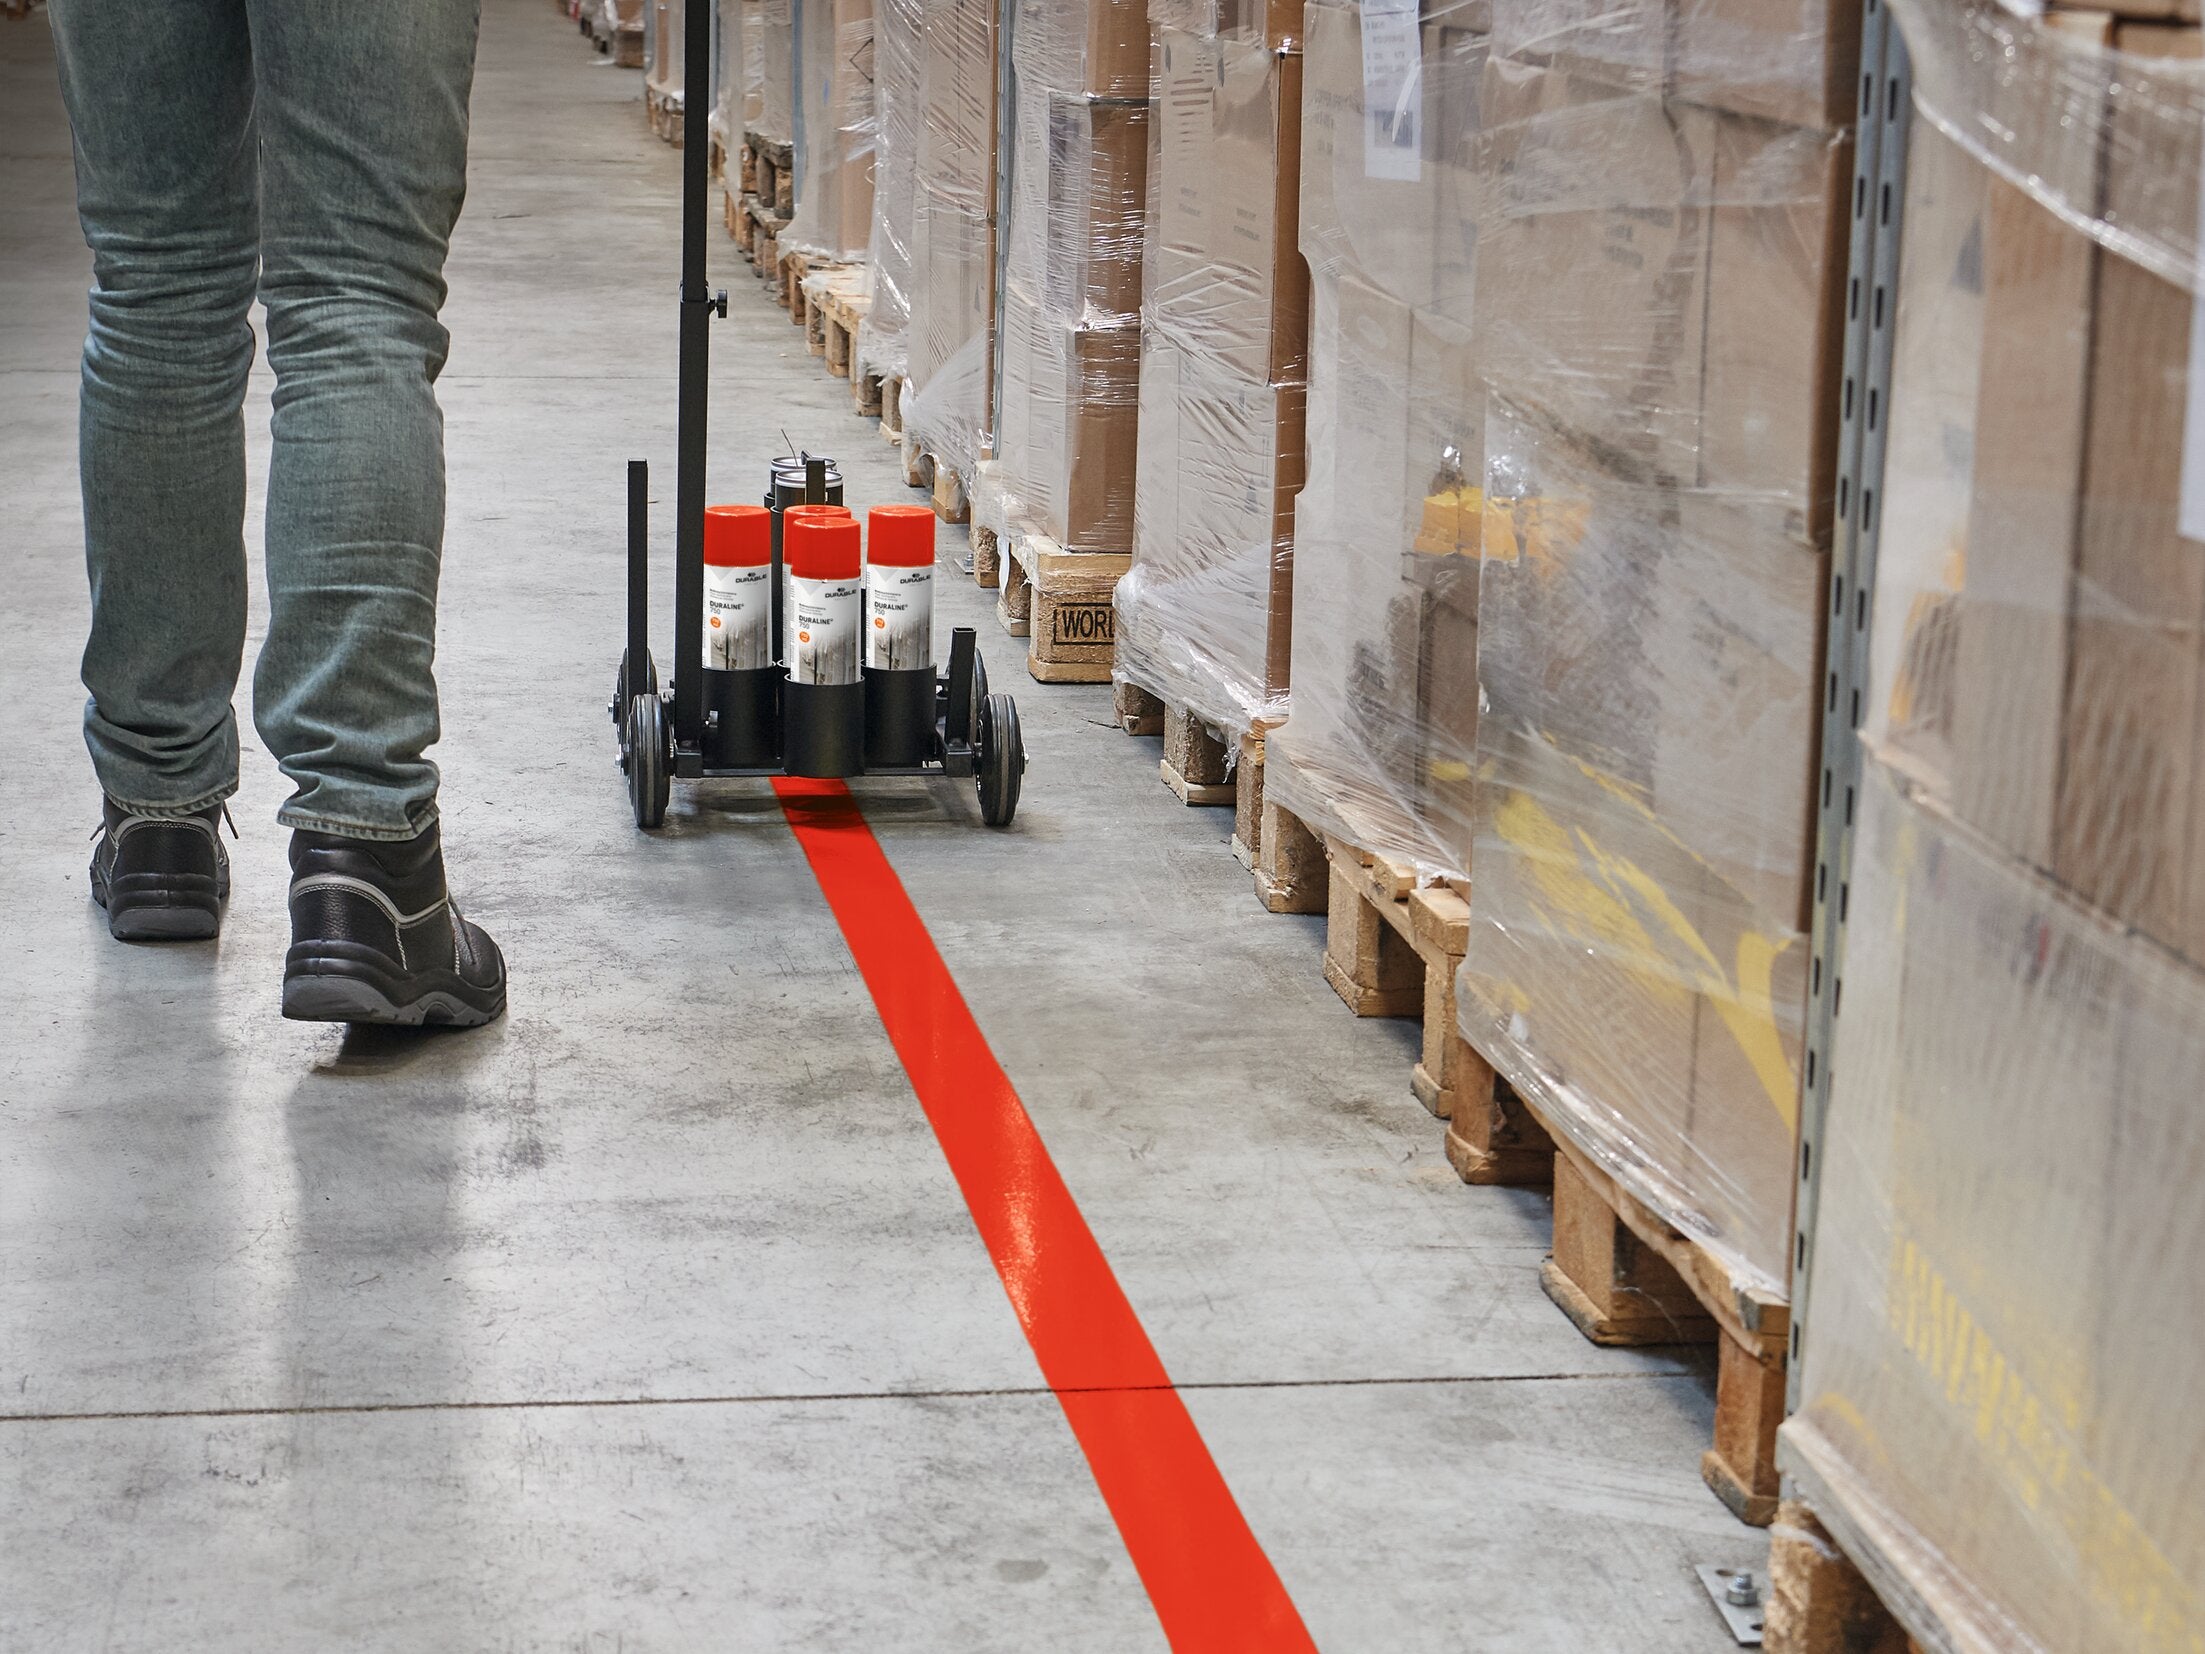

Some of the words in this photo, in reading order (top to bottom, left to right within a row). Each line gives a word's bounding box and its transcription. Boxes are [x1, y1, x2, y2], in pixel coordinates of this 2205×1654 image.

[735, 574, 767, 583] DURABLE
[900, 575, 931, 584] DURABLE
[825, 589, 857, 598] DURABLE
